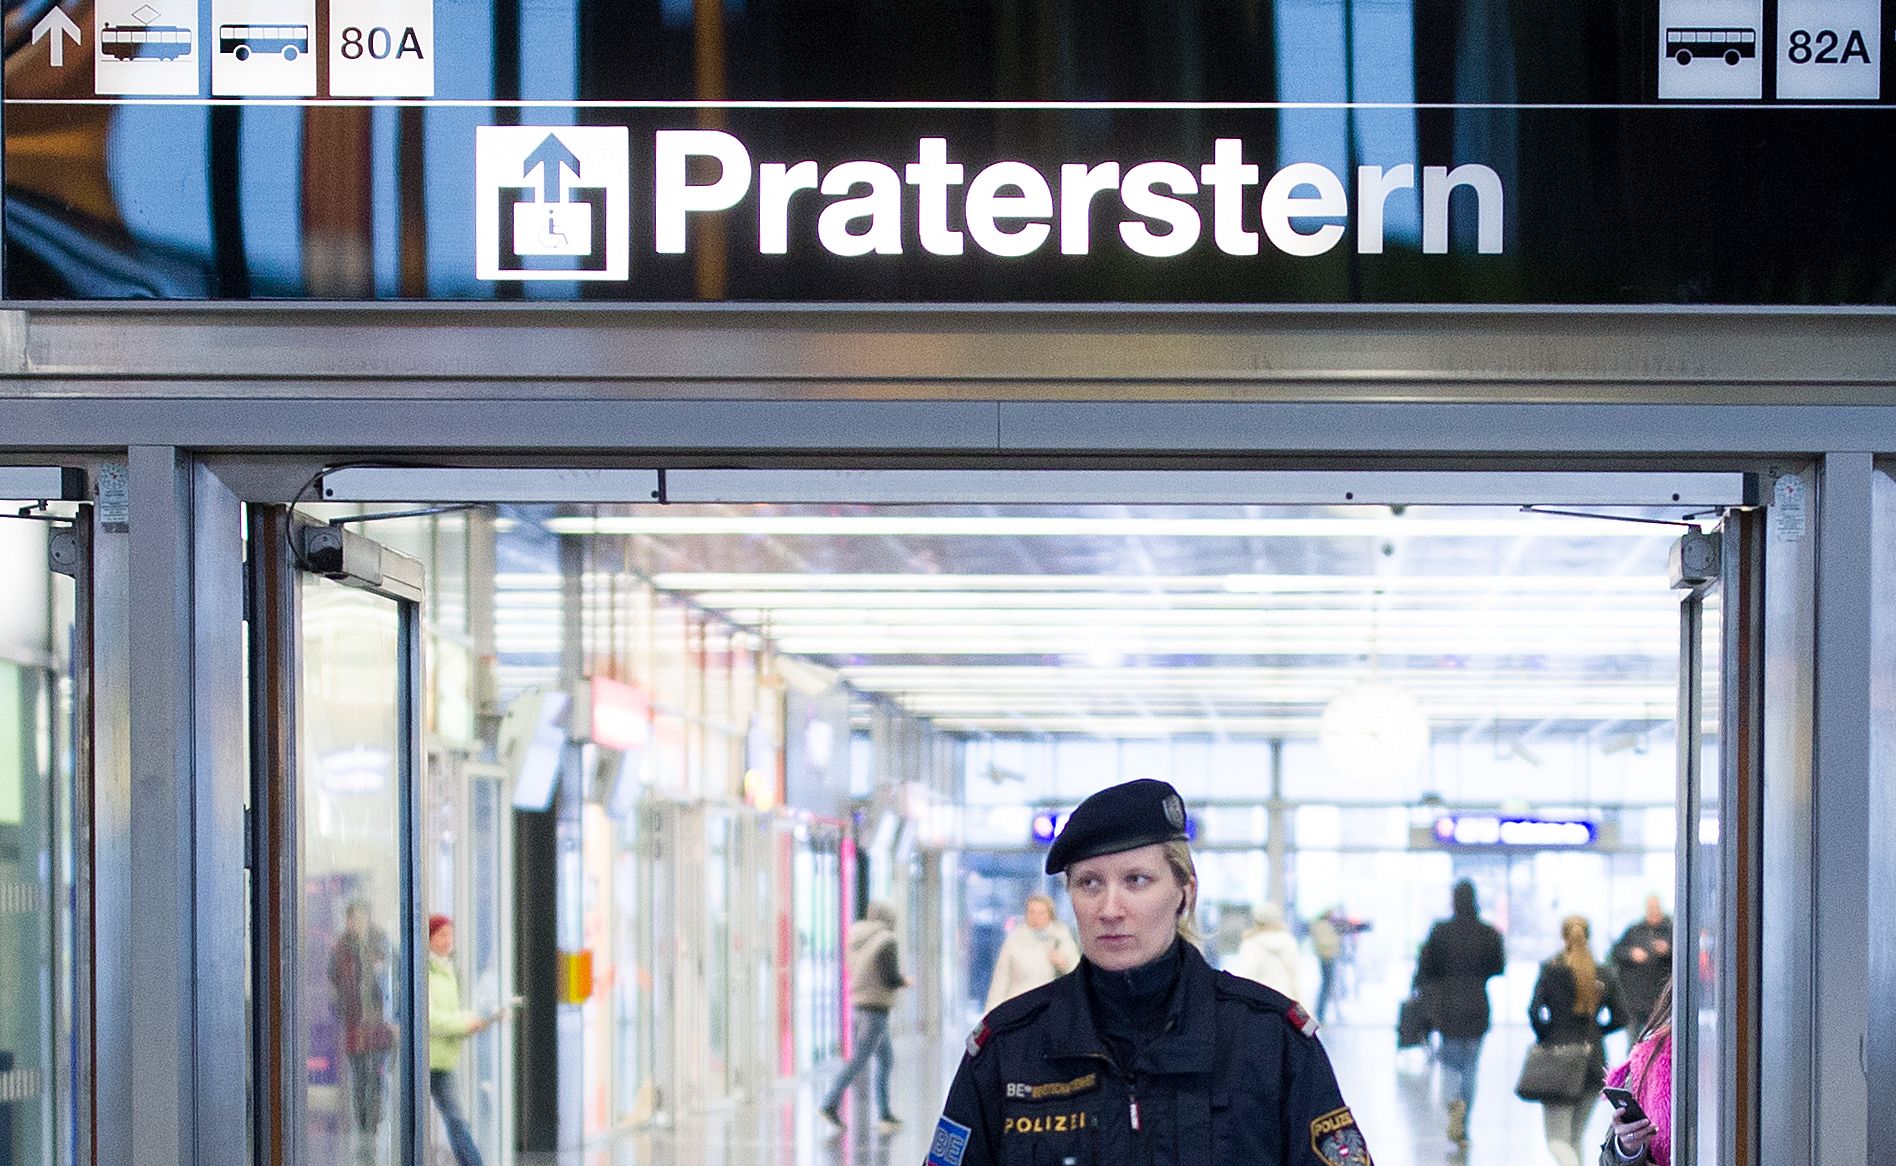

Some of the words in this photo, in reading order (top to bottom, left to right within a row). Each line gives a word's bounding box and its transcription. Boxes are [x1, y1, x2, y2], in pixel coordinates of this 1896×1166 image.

[341, 27, 425, 61] 80A
[1787, 29, 1872, 64] 82A
[655, 130, 1504, 257] Praterstern
[1003, 1112, 1087, 1134] POLIZEI
